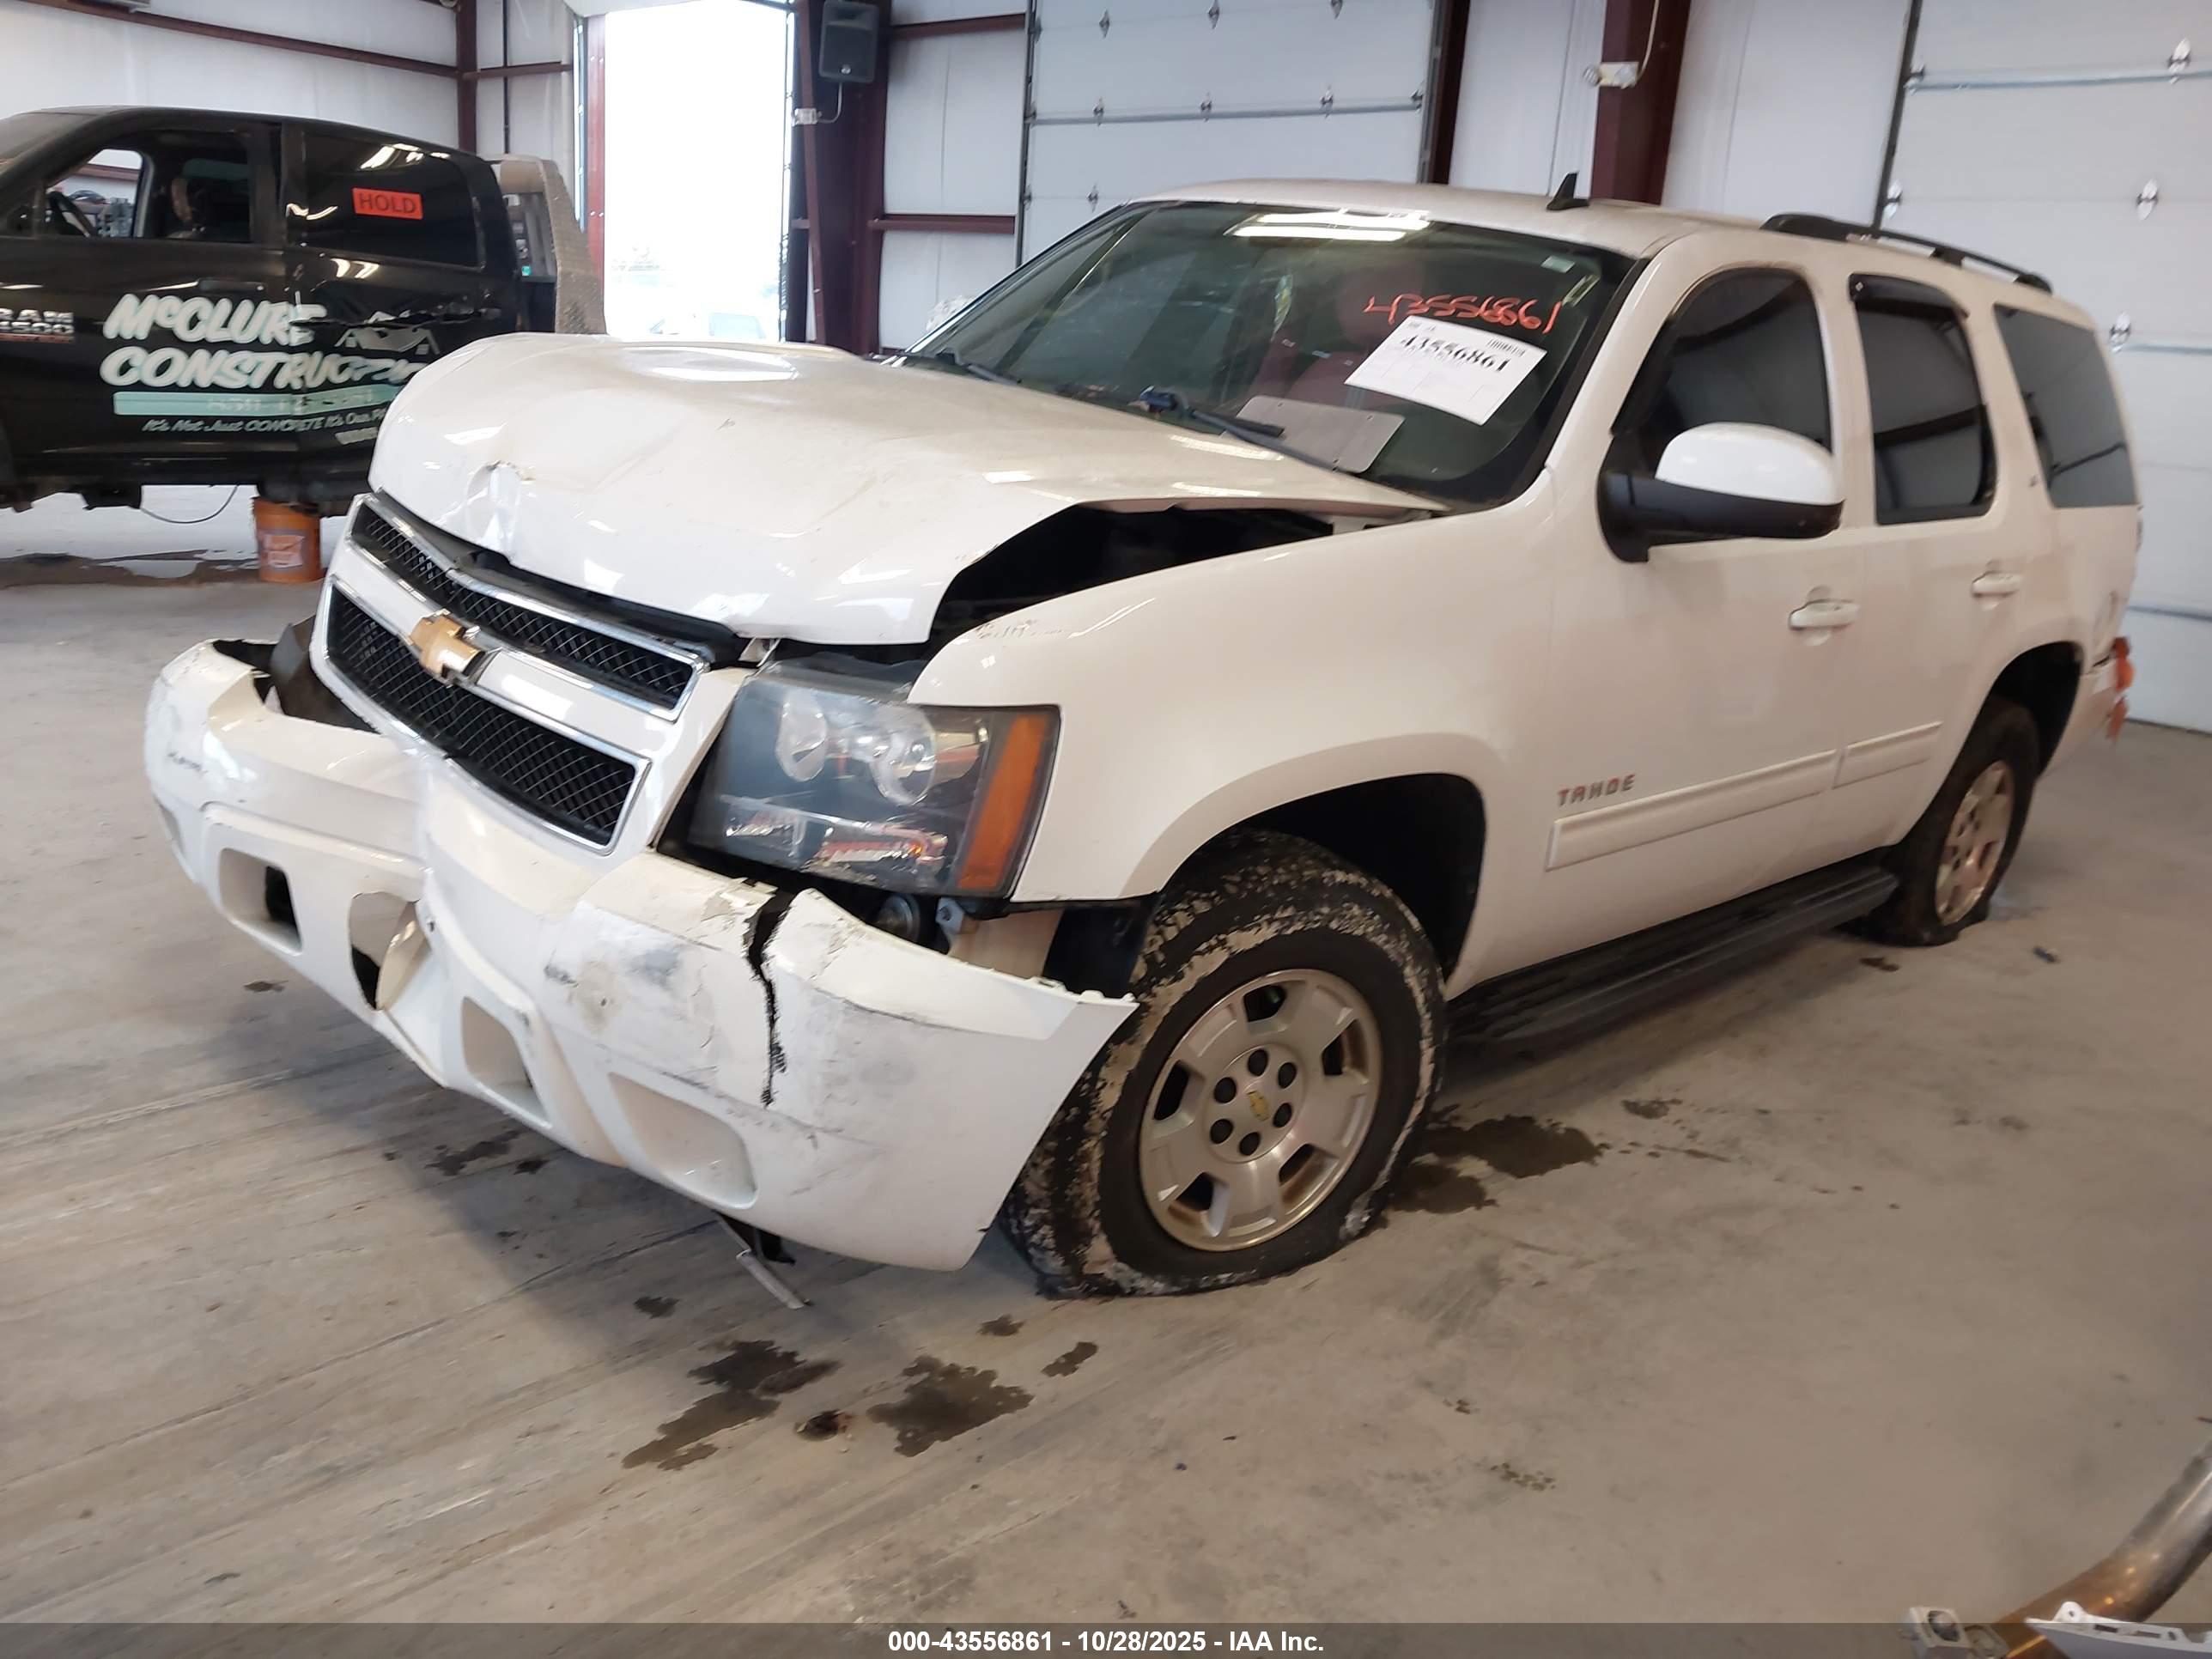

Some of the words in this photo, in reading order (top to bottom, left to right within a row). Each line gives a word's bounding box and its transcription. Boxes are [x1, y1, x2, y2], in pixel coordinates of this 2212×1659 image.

[359, 192, 416, 214] HOLD
[1401, 334, 1511, 374] 43556861
[1558, 773, 1636, 807] TAHOE
